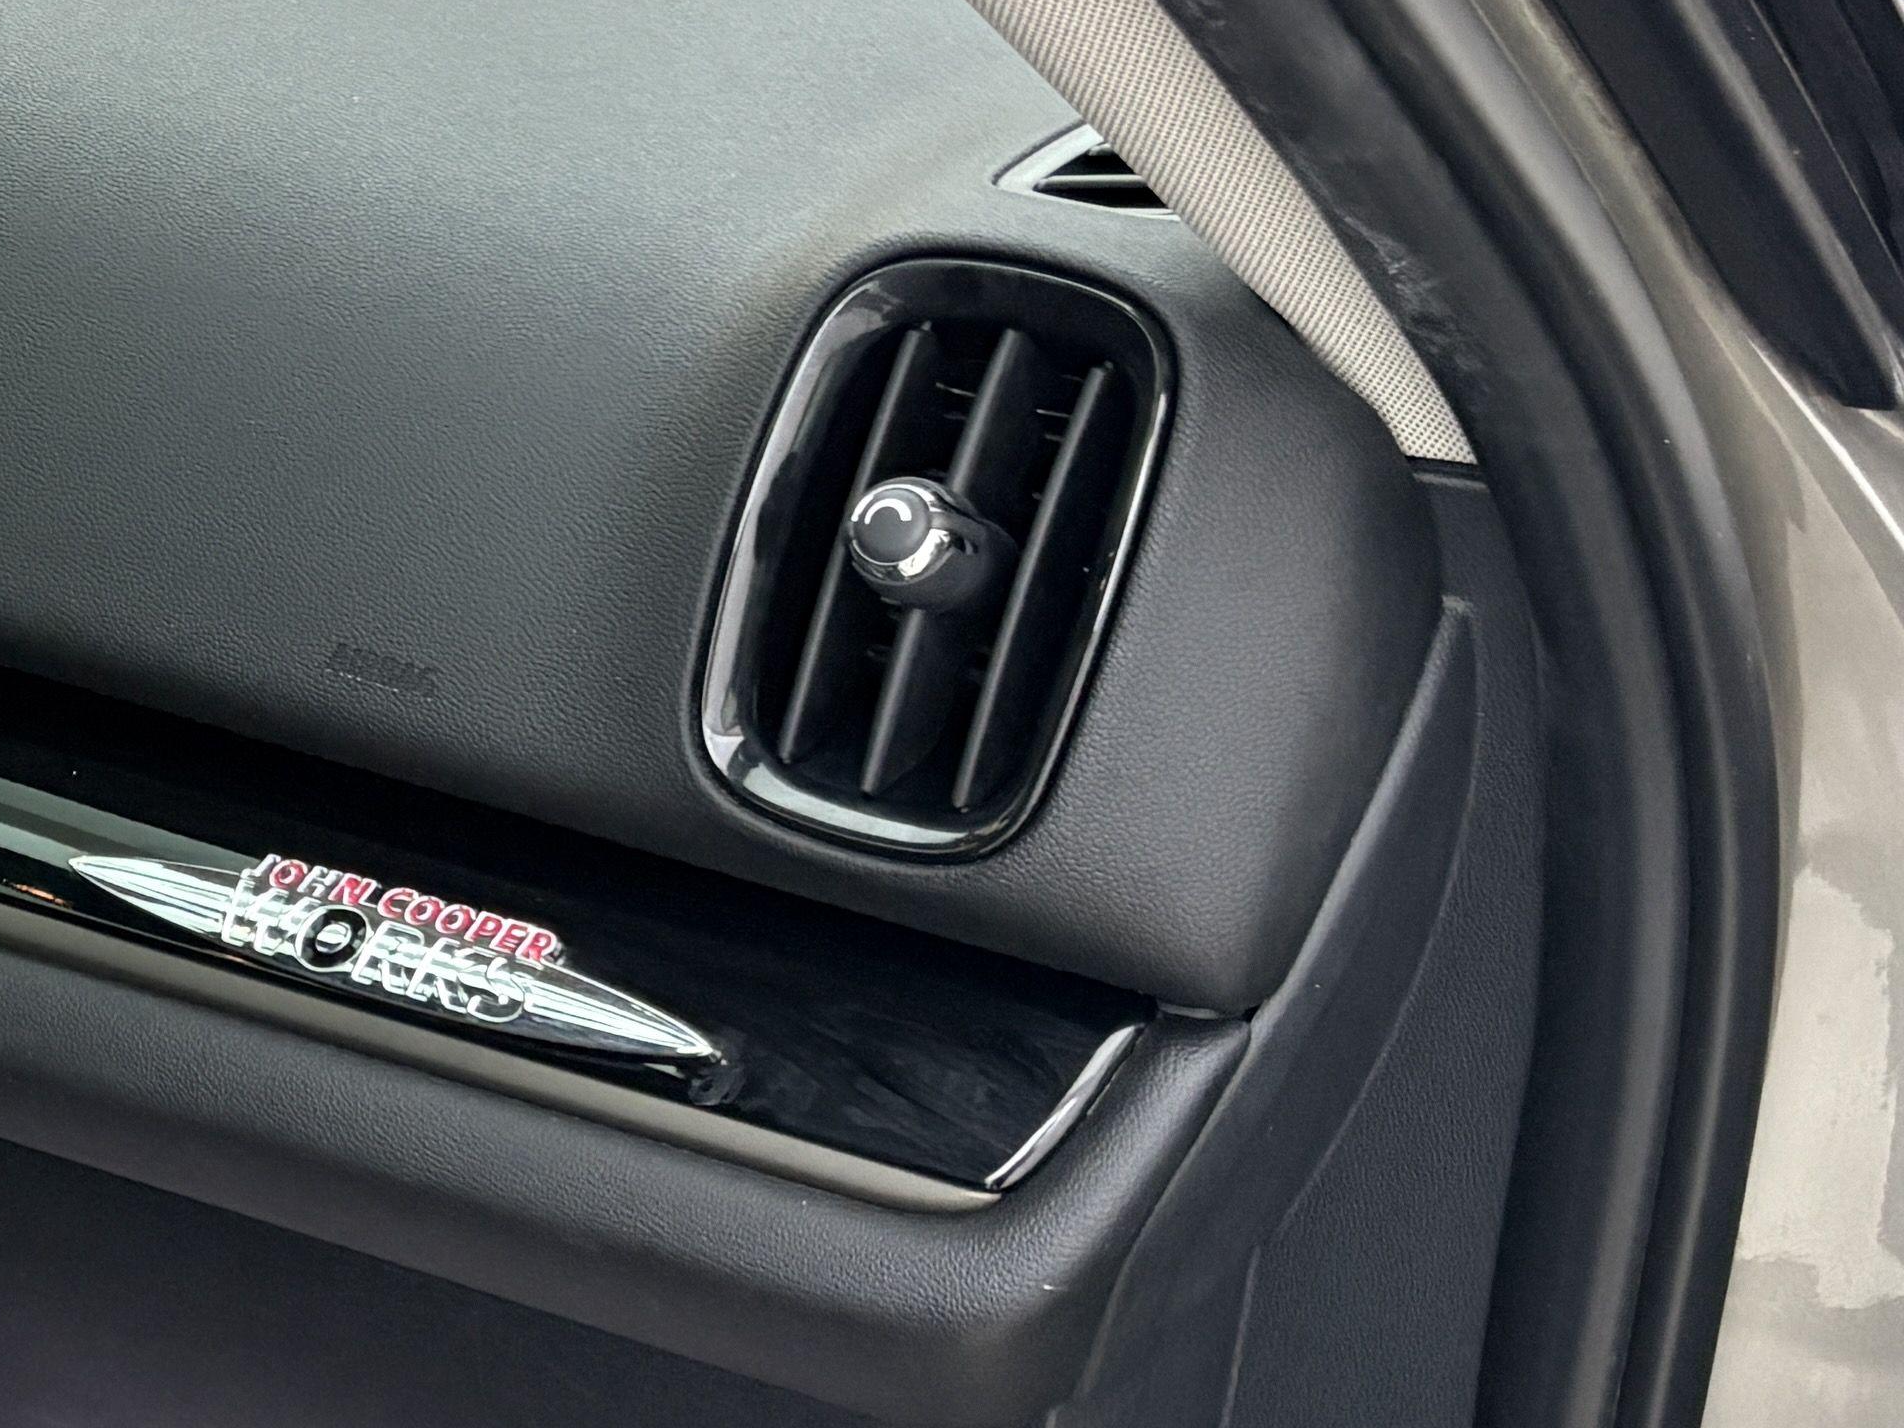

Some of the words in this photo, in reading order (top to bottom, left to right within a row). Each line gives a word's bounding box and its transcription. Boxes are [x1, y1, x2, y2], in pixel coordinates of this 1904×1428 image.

[220, 870, 528, 1024] WORKS
[242, 852, 384, 910] JOHN
[376, 885, 568, 970] COOPER
